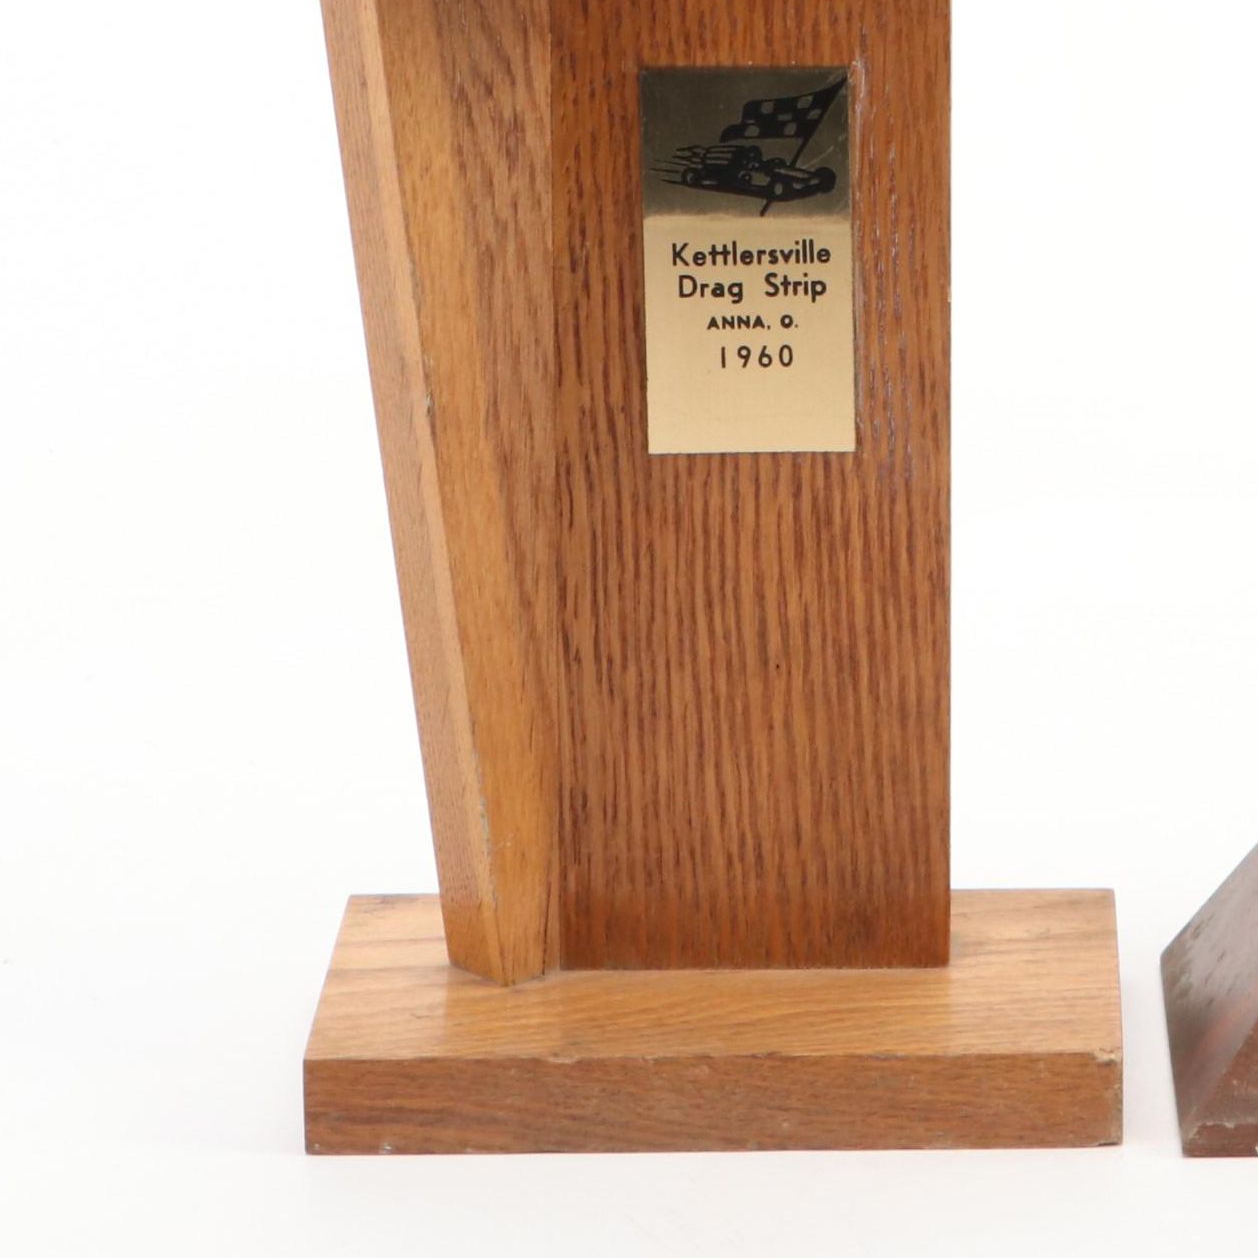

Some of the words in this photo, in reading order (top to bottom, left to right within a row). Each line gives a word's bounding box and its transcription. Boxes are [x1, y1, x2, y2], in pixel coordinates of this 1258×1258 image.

[671, 238, 831, 267] Kettlersville
[678, 274, 744, 304] Drag
[764, 272, 827, 303] Strip
[706, 315, 772, 331] ANNA,
[779, 314, 799, 330] O.
[720, 344, 794, 369] 1960
